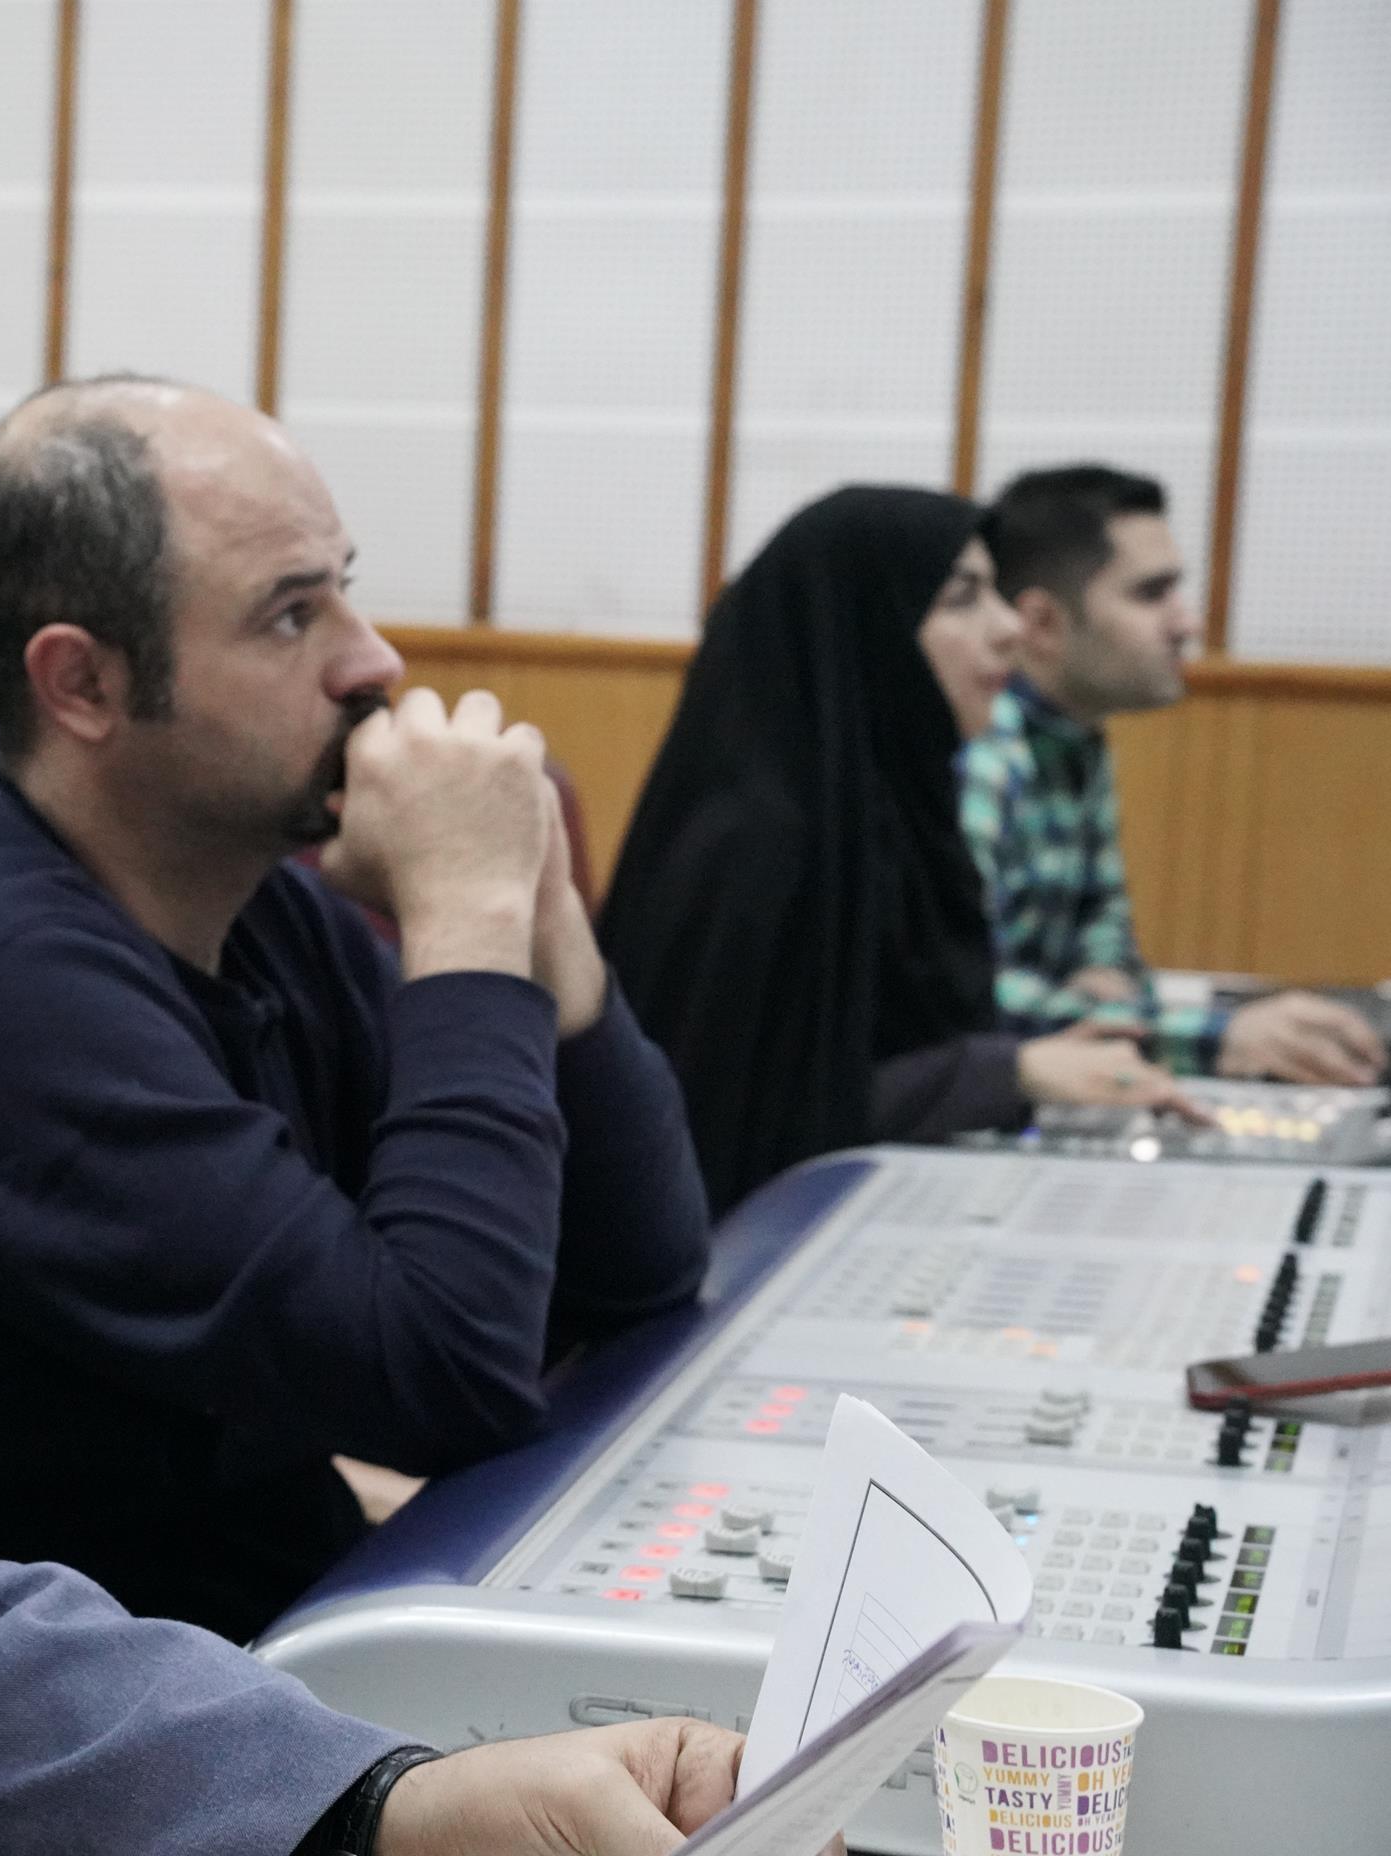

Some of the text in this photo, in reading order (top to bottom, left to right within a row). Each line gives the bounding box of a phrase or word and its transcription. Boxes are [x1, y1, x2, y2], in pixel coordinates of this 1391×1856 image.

[981, 1739, 1122, 1769] DELICIOUS
[982, 1766, 1051, 1787] YUMMY
[1077, 1770, 1105, 1793] OH
[984, 1786, 1053, 1811] TASTY
[1057, 1773, 1072, 1810] YUMMY
[988, 1808, 1073, 1829] DELICIOUS
[989, 1826, 1114, 1856] DELICIOUS
